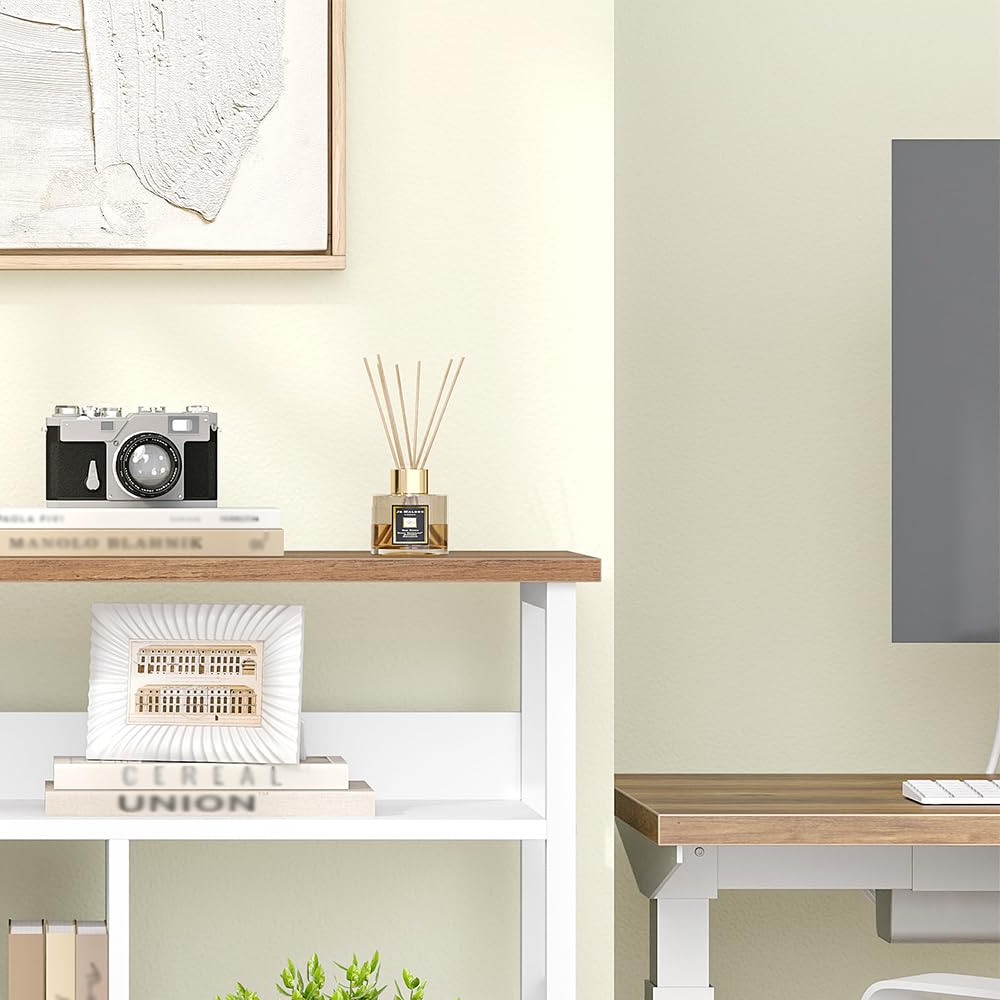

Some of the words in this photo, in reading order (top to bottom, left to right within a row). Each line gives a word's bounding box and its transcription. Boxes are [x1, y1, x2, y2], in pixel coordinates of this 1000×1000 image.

[8, 536, 100, 550] MANOLO
[106, 536, 204, 550] BLAHNIK
[121, 765, 283, 787] CEREAL
[117, 794, 256, 813] UNION
